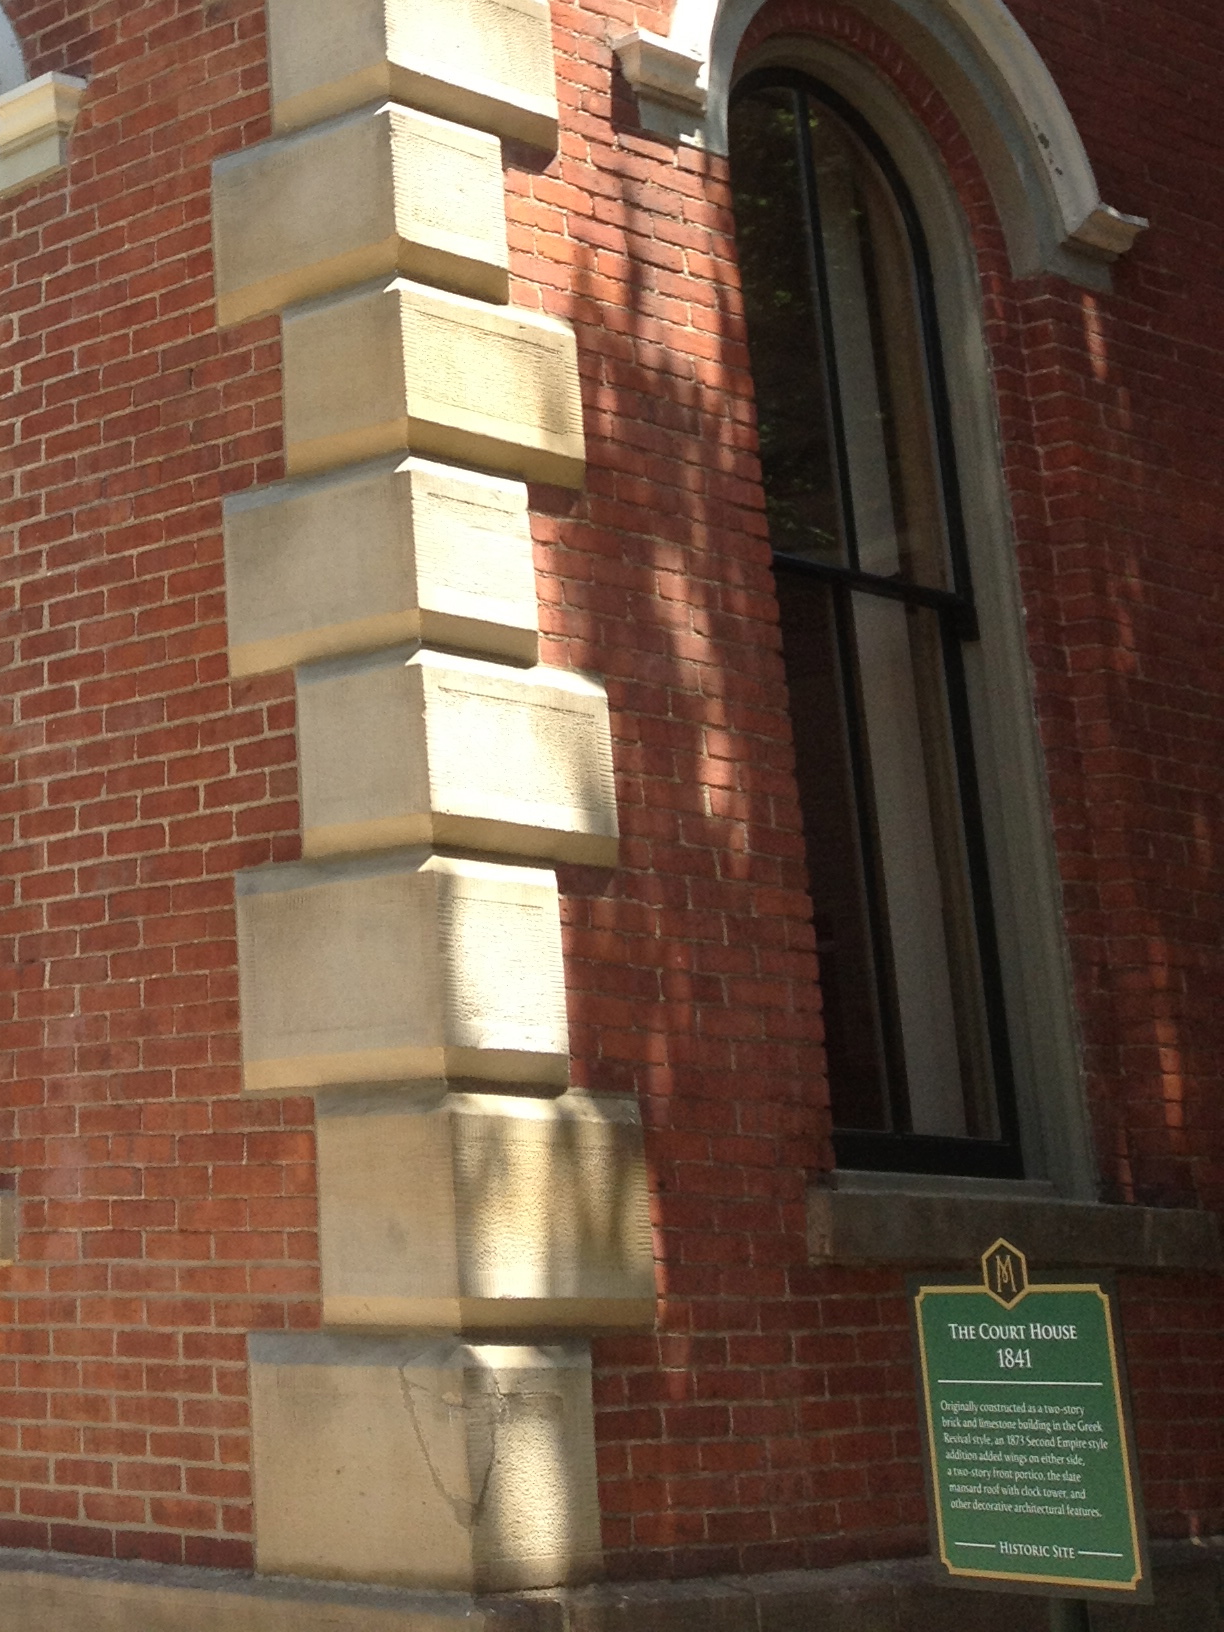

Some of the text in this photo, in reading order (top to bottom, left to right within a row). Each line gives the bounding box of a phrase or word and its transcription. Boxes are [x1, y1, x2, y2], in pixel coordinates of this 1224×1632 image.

[948, 1323, 1077, 1340] THE COURT HOUSE
[997, 1348, 1032, 1368] 1841
[940, 1400, 978, 1414] Originally
[979, 1402, 1026, 1413] constructed
[1027, 1405, 1036, 1413] as
[1044, 1405, 1085, 1418] two-story
[942, 1416, 1103, 1434] brick and limestone building in the Greek
[943, 1432, 1108, 1452] Revival style, an 1873 Second Empire style
[945, 1449, 1085, 1466] addition added wings on either side,
[947, 1468, 952, 1476] a
[953, 1468, 991, 1481] two-story
[992, 1467, 1013, 1478] front
[1047, 1470, 1061, 1481] the
[1062, 1470, 1082, 1482] slate
[949, 1483, 1086, 1499] mansard roof with clock tower, and
[950, 1498, 1102, 1517] other decorative architectural features.
[999, 1541, 1076, 1559] HISTORIC SITE
